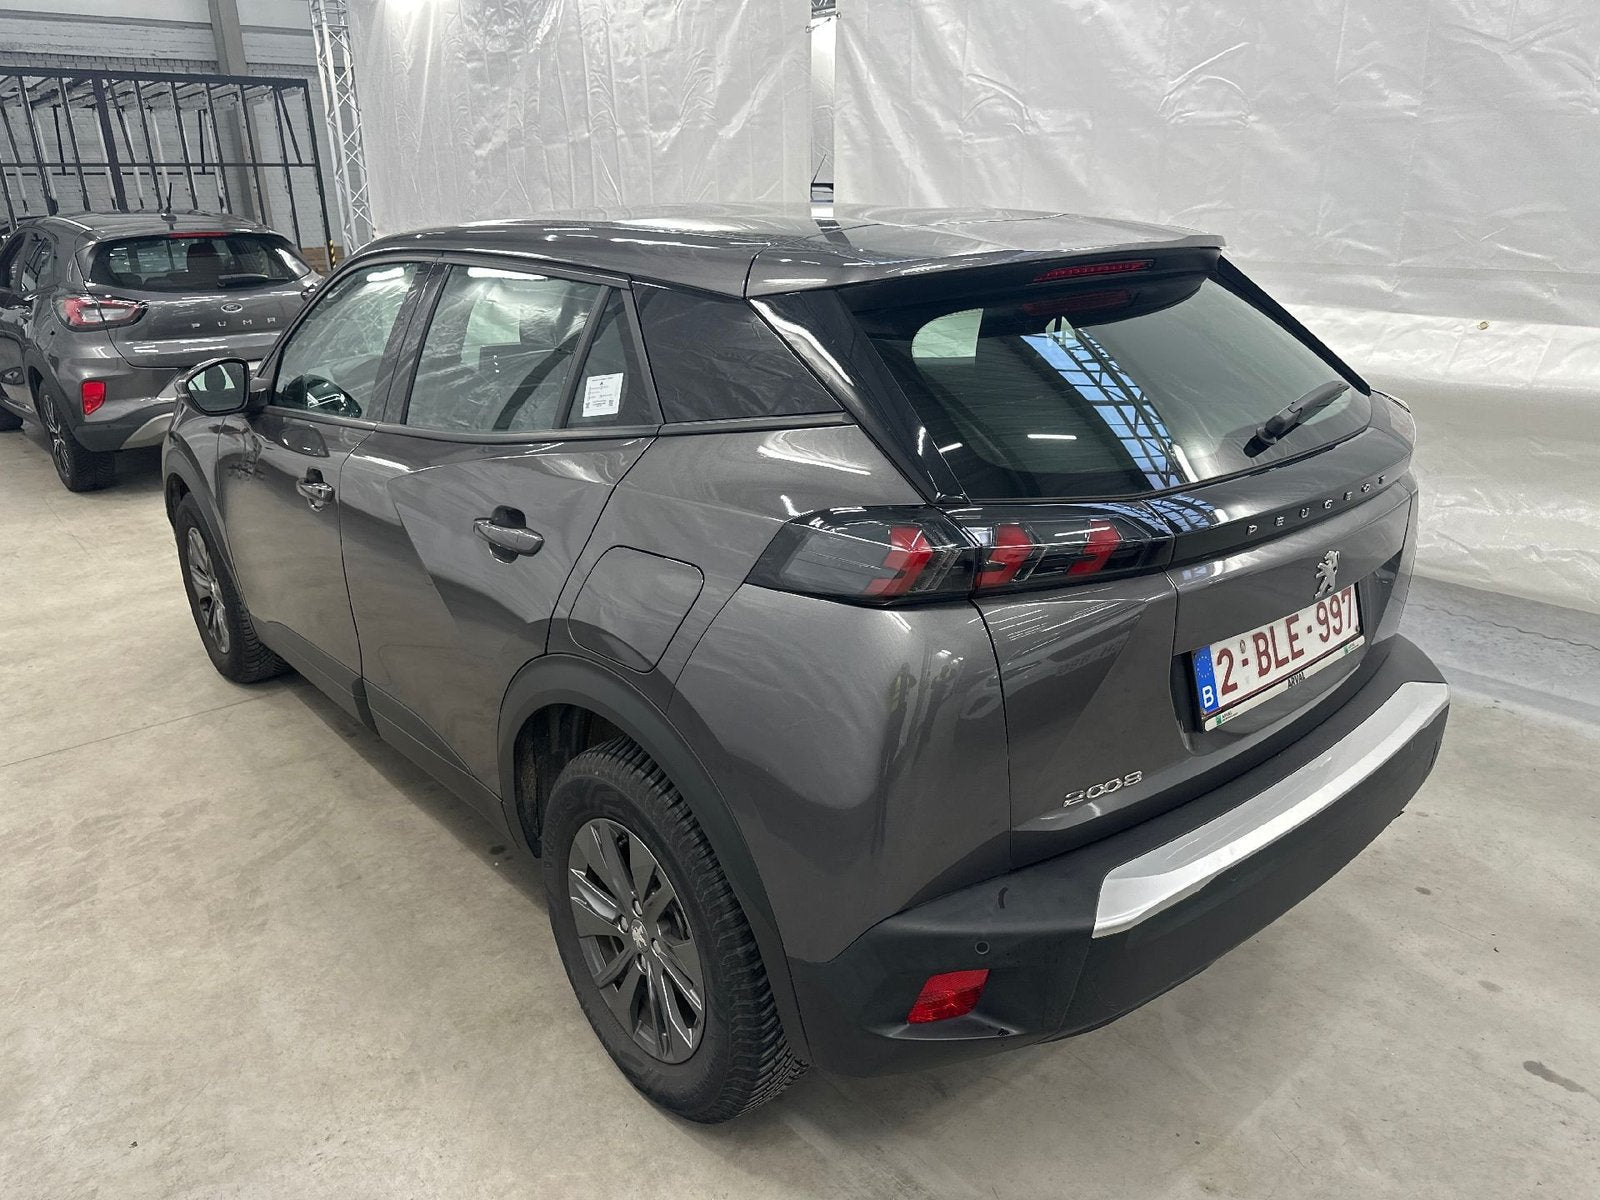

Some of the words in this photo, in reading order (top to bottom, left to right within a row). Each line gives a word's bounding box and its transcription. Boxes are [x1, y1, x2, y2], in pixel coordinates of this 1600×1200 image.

[191, 317, 276, 329] PUMA
[1246, 474, 1386, 535] PEUGEOT
[1216, 587, 1352, 696] 2-BLE-997
[1287, 671, 1306, 689] ARVAL
[1202, 685, 1214, 708] B
[1063, 770, 1143, 808] 2008
